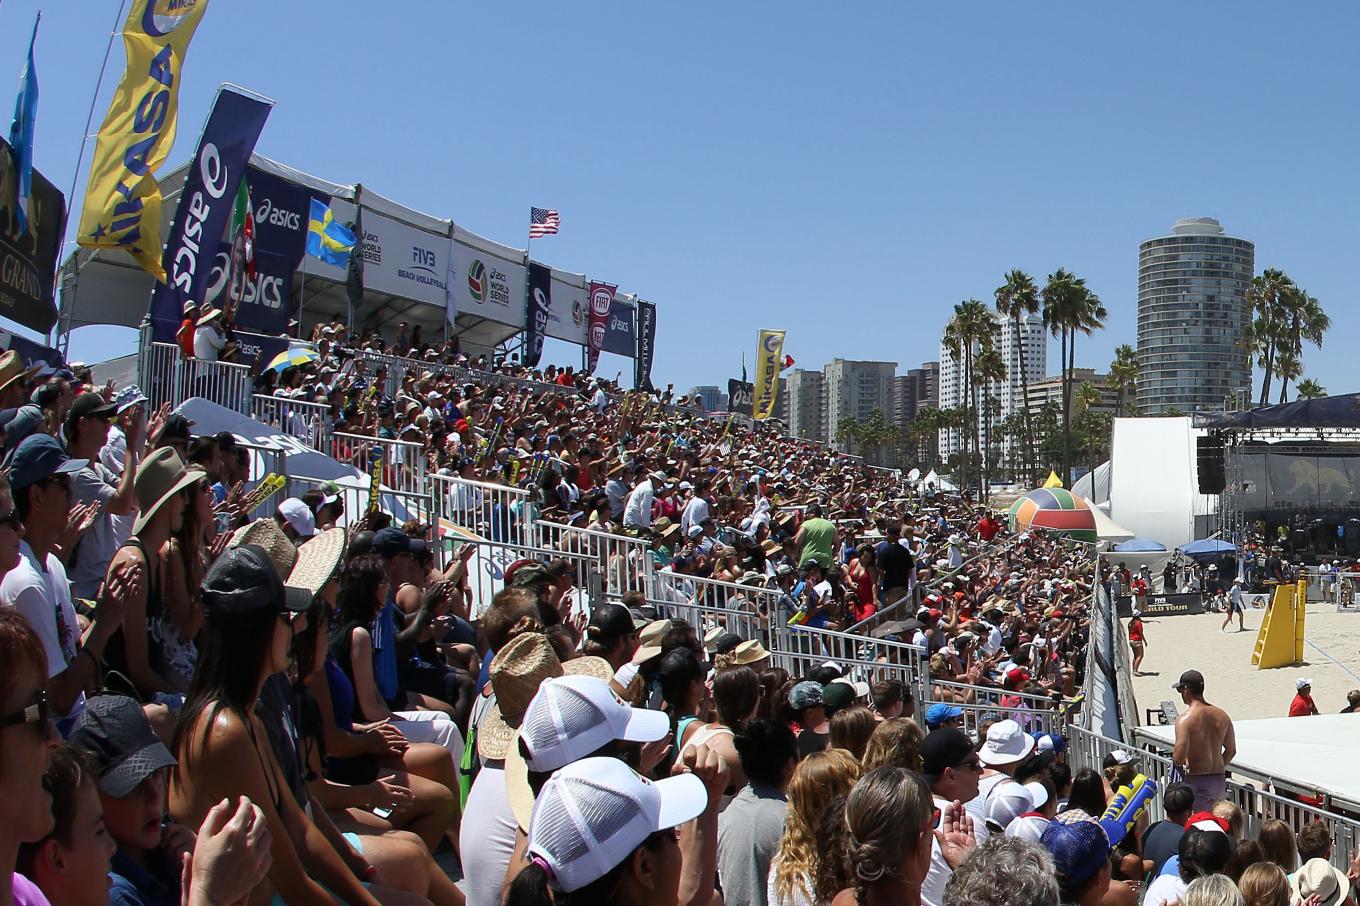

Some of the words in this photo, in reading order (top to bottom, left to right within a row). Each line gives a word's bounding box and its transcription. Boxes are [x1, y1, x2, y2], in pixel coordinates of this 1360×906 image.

[109, 43, 174, 246] MIKASA
[269, 207, 301, 231] asics
[173, 191, 210, 294] asics
[362, 250, 382, 263] ERIES
[412, 246, 436, 267] FIVB
[2, 253, 42, 301] GRAND
[490, 281, 510, 295] WORLD
[490, 290, 510, 305] SERIES
[596, 295, 610, 310] FIAT
[616, 321, 629, 333] asics
[760, 354, 775, 414] MIKASA
[1165, 604, 1189, 612] TOUR
